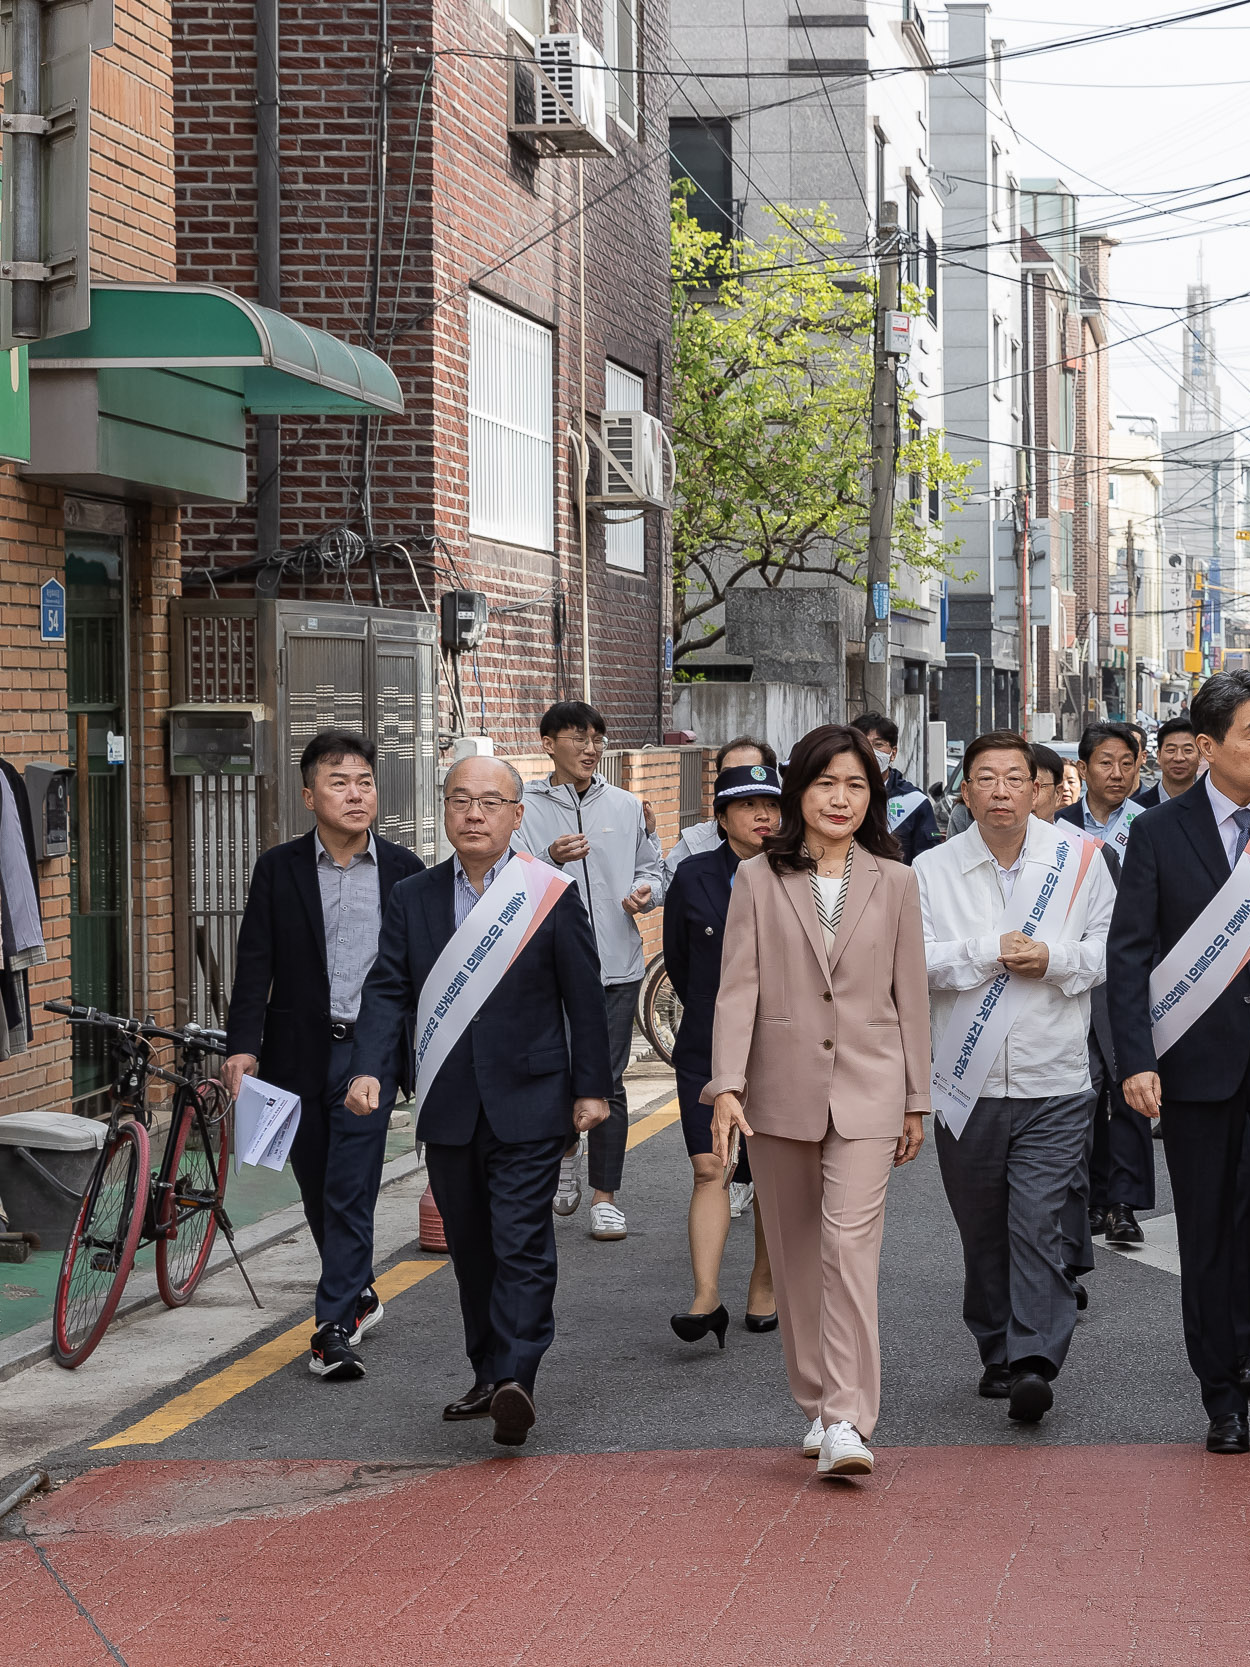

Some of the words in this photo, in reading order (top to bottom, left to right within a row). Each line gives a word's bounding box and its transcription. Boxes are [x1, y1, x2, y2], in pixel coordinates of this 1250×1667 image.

[48, 609, 59, 632] 54
[498, 890, 527, 926] 소중한
[1029, 871, 1059, 924] 아이들의
[463, 924, 504, 974] 아이들의
[1185, 933, 1230, 984] 아이들의
[434, 970, 470, 1020] 등하굣길
[976, 972, 1011, 1023] 안전하게
[1152, 977, 1191, 1022] 등하굣길
[952, 1020, 984, 1081] 지켜주세요
